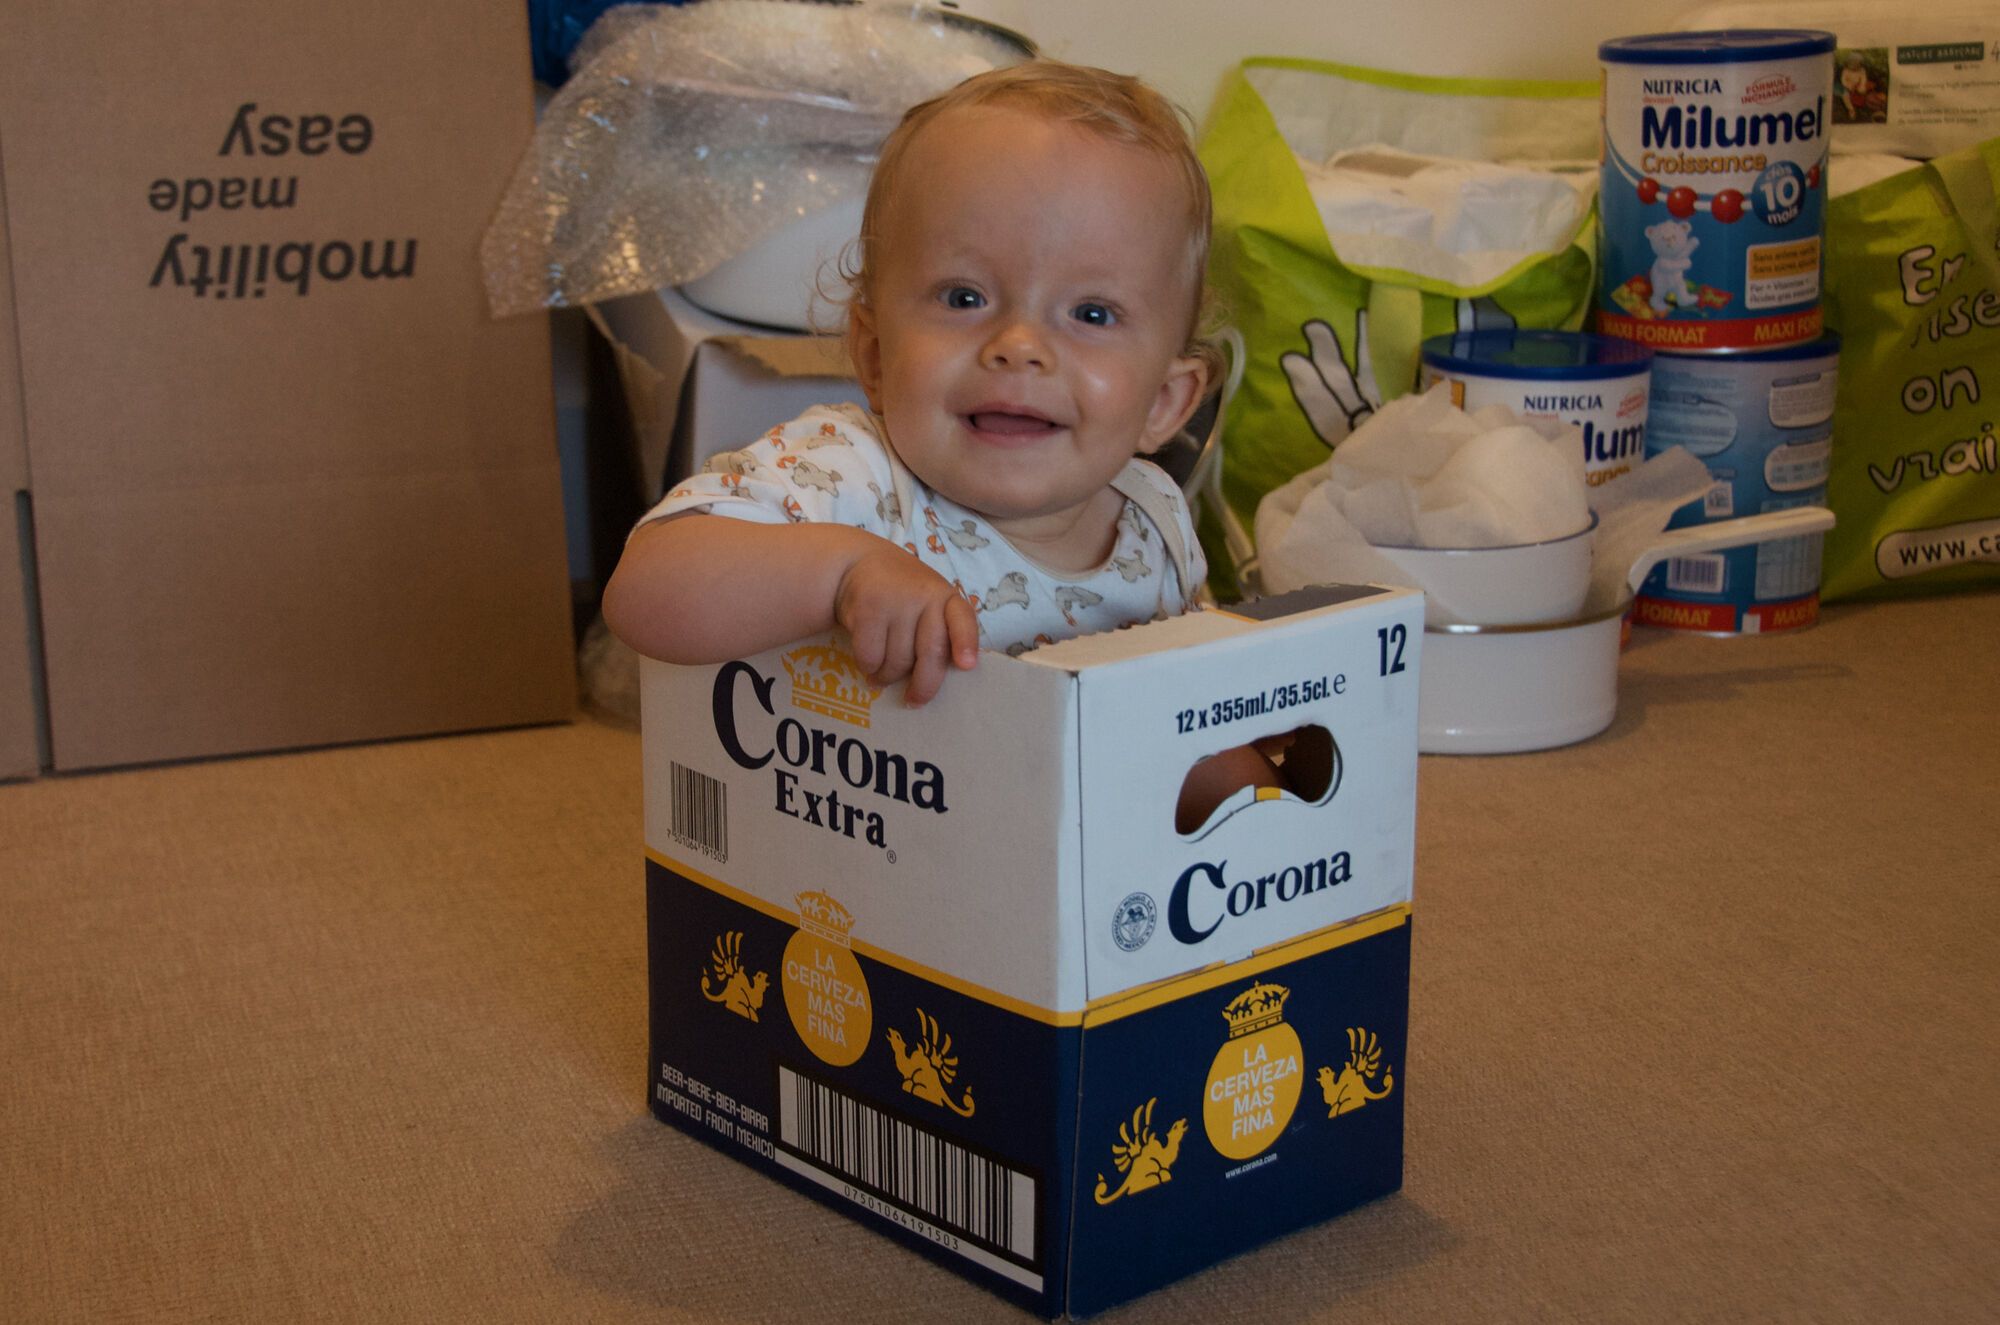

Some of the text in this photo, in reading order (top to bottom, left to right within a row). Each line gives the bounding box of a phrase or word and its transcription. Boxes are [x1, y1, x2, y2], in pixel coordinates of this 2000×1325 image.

[1642, 79, 1722, 95] NUTRICIA
[217, 102, 374, 156] easy
[1641, 95, 1823, 149] Milumel
[1640, 150, 1767, 175] Croissance
[148, 176, 298, 222] made
[1759, 175, 1800, 212] 10
[1767, 206, 1799, 225] mois
[149, 233, 418, 299] mobility
[1636, 325, 1708, 345] FORMAT
[1753, 320, 1795, 342] MAXI
[1523, 394, 1603, 411] NUTRICIA
[1901, 366, 1981, 415] on
[1641, 603, 1711, 625] FORMAT
[1377, 623, 1408, 677] 12
[712, 660, 949, 814] Corona
[1175, 708, 1194, 735] 12
[1198, 709, 1208, 730] x
[774, 768, 887, 849] Extra
[1168, 850, 1353, 946] Corona
[815, 948, 837, 976] LA
[786, 960, 867, 1012] CERVEZA
[808, 990, 846, 1025] MAS
[808, 1014, 848, 1048] FINA
[1243, 1043, 1268, 1068] LA
[1210, 1055, 1298, 1102] CERVEZA
[1233, 1085, 1275, 1117] MAS
[656, 1082, 775, 1160] IMPORTED FROM MEXICO
[1232, 1108, 1275, 1140] FINA
[844, 1185, 959, 1250] 07501064191503
